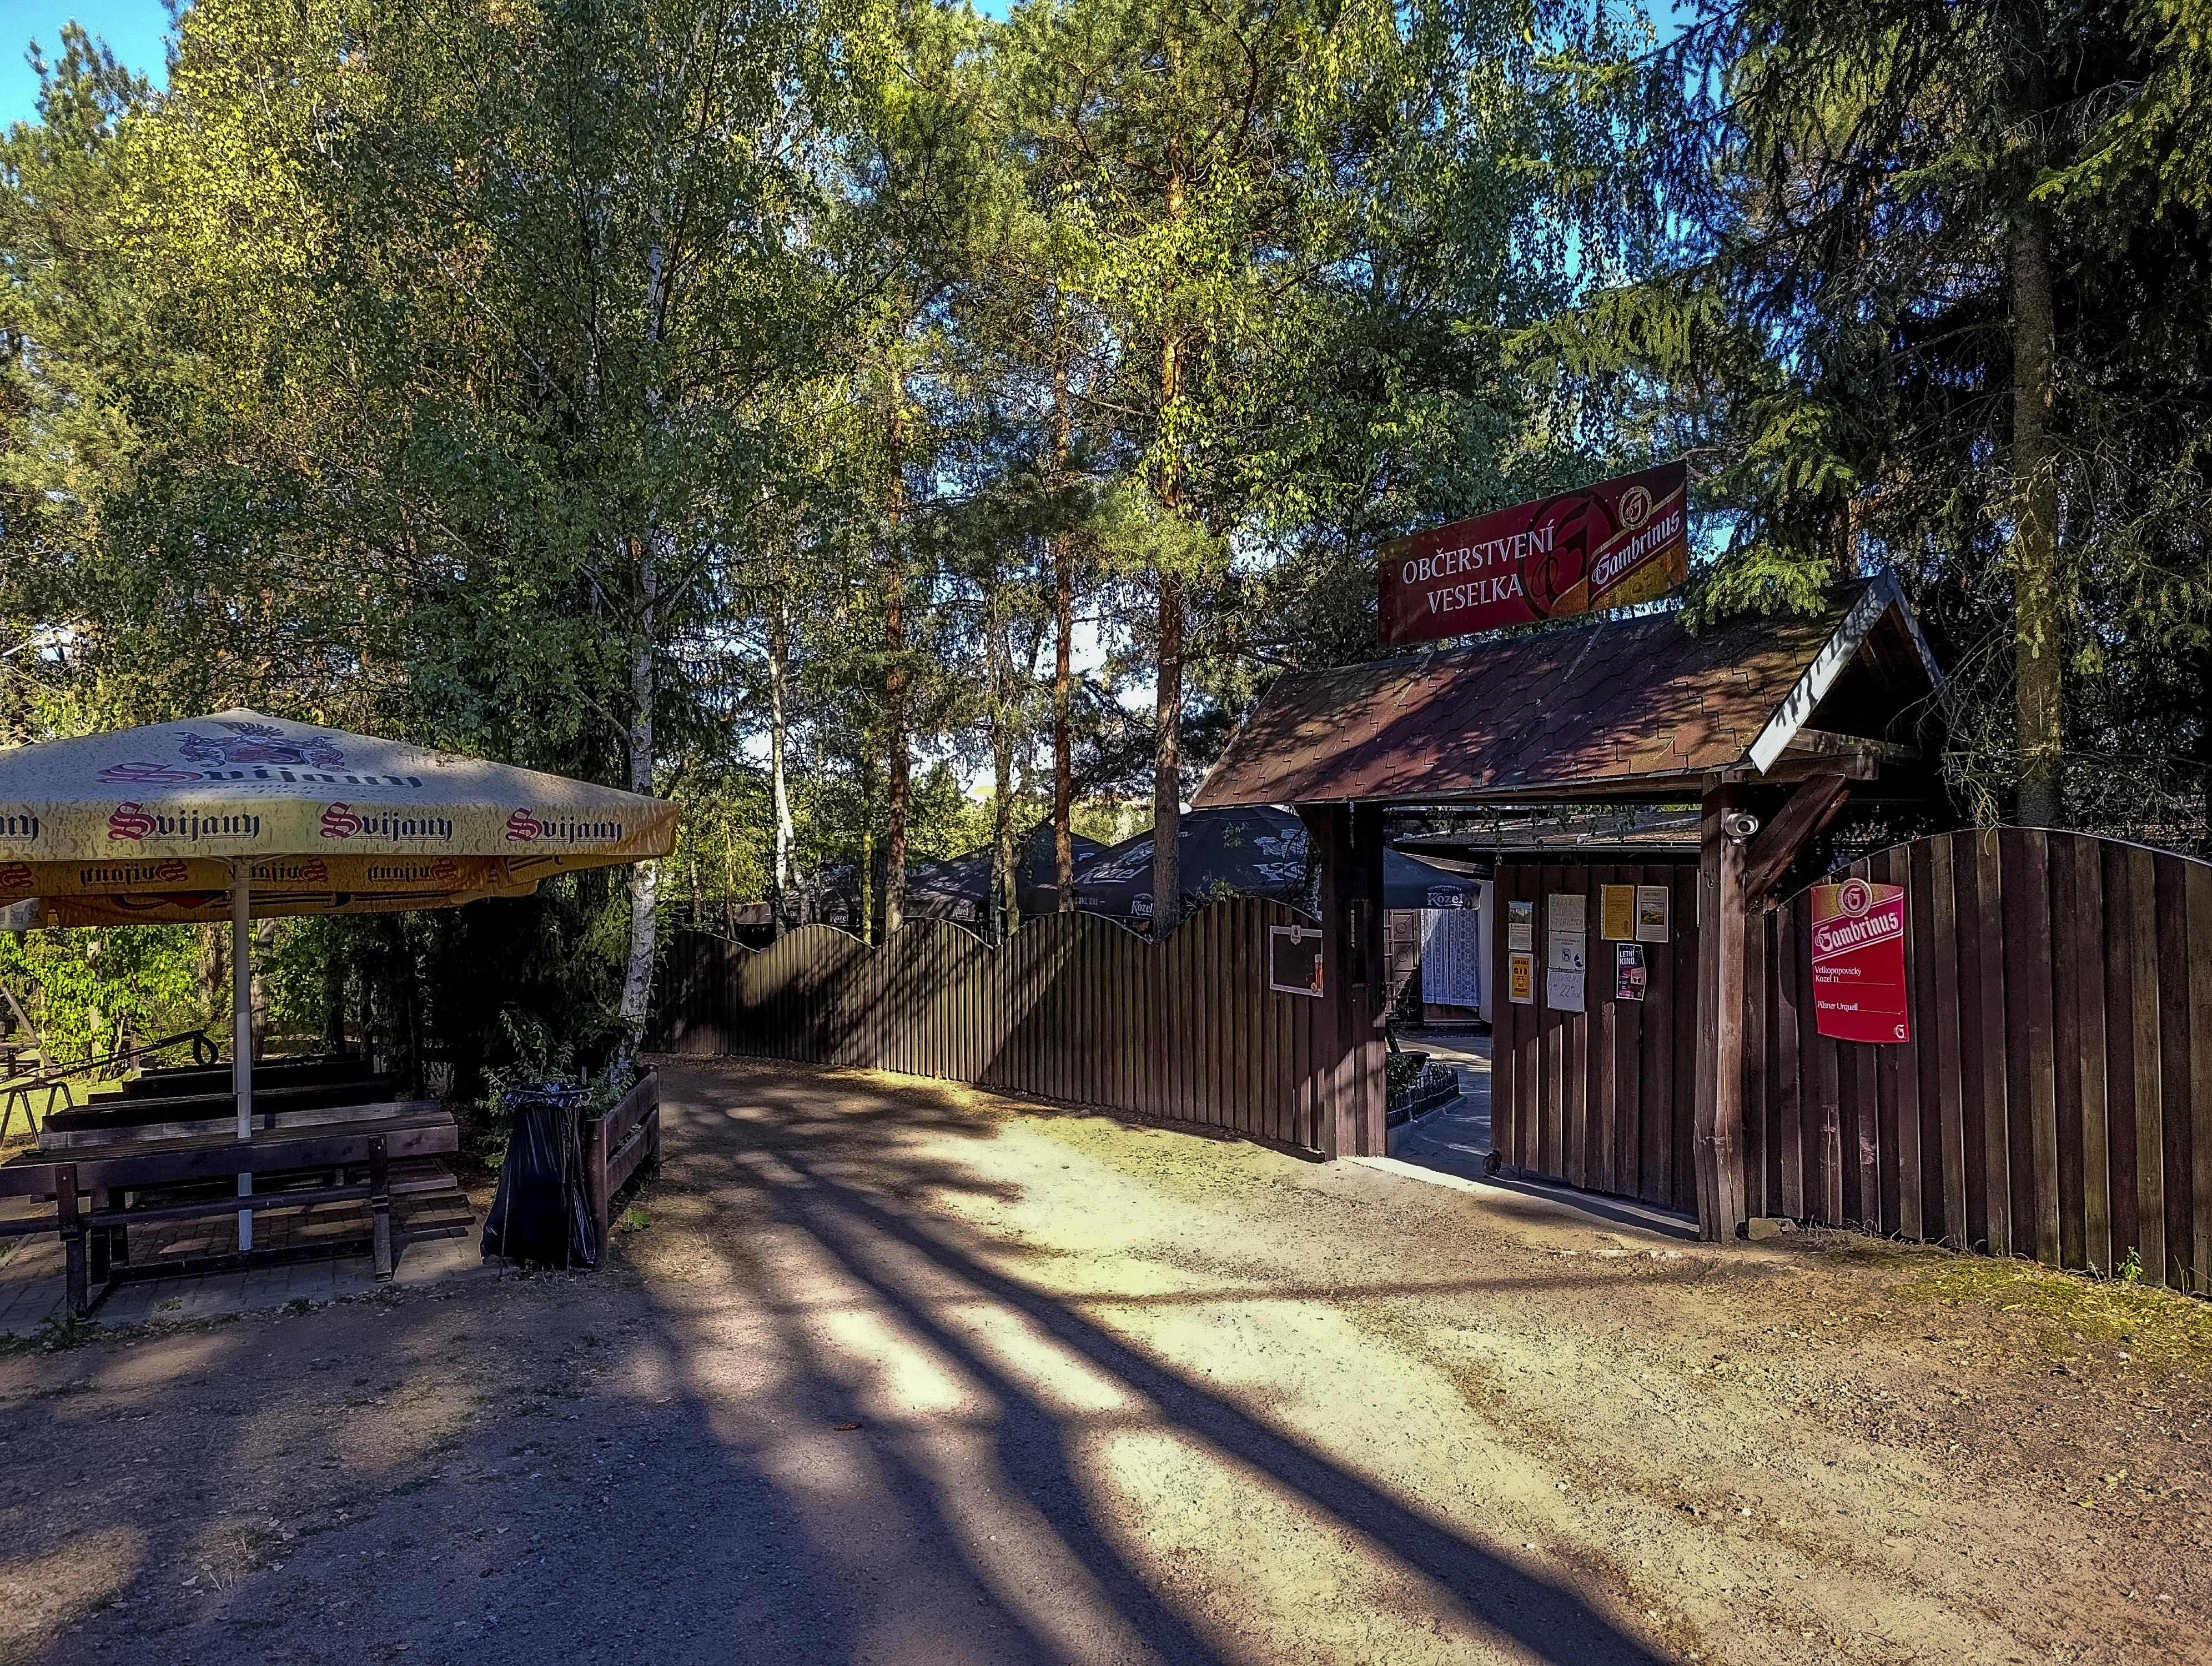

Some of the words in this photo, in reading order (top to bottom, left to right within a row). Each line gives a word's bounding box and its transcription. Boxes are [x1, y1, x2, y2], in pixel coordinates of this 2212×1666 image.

[1402, 519, 1554, 584] OBČERSTVENÍ
[1591, 510, 1680, 585] Gambrinus
[1427, 574, 1524, 614] VESELKA
[95, 761, 423, 788] Svijany
[108, 801, 260, 842] Svijany
[319, 801, 453, 842] Svijany
[505, 807, 622, 844] Svijany
[952, 906, 968, 918] Kozel
[1131, 900, 1153, 916] Kozel
[1426, 892, 1463, 907] Kozel
[1815, 912, 1899, 951] Gambrinus
[1620, 949, 1635, 957] LETNÍ
[1814, 966, 1862, 976] Velkopopovický
[1817, 1001, 1836, 1009] Pilsner
[1837, 1002, 1858, 1012] Urquell
